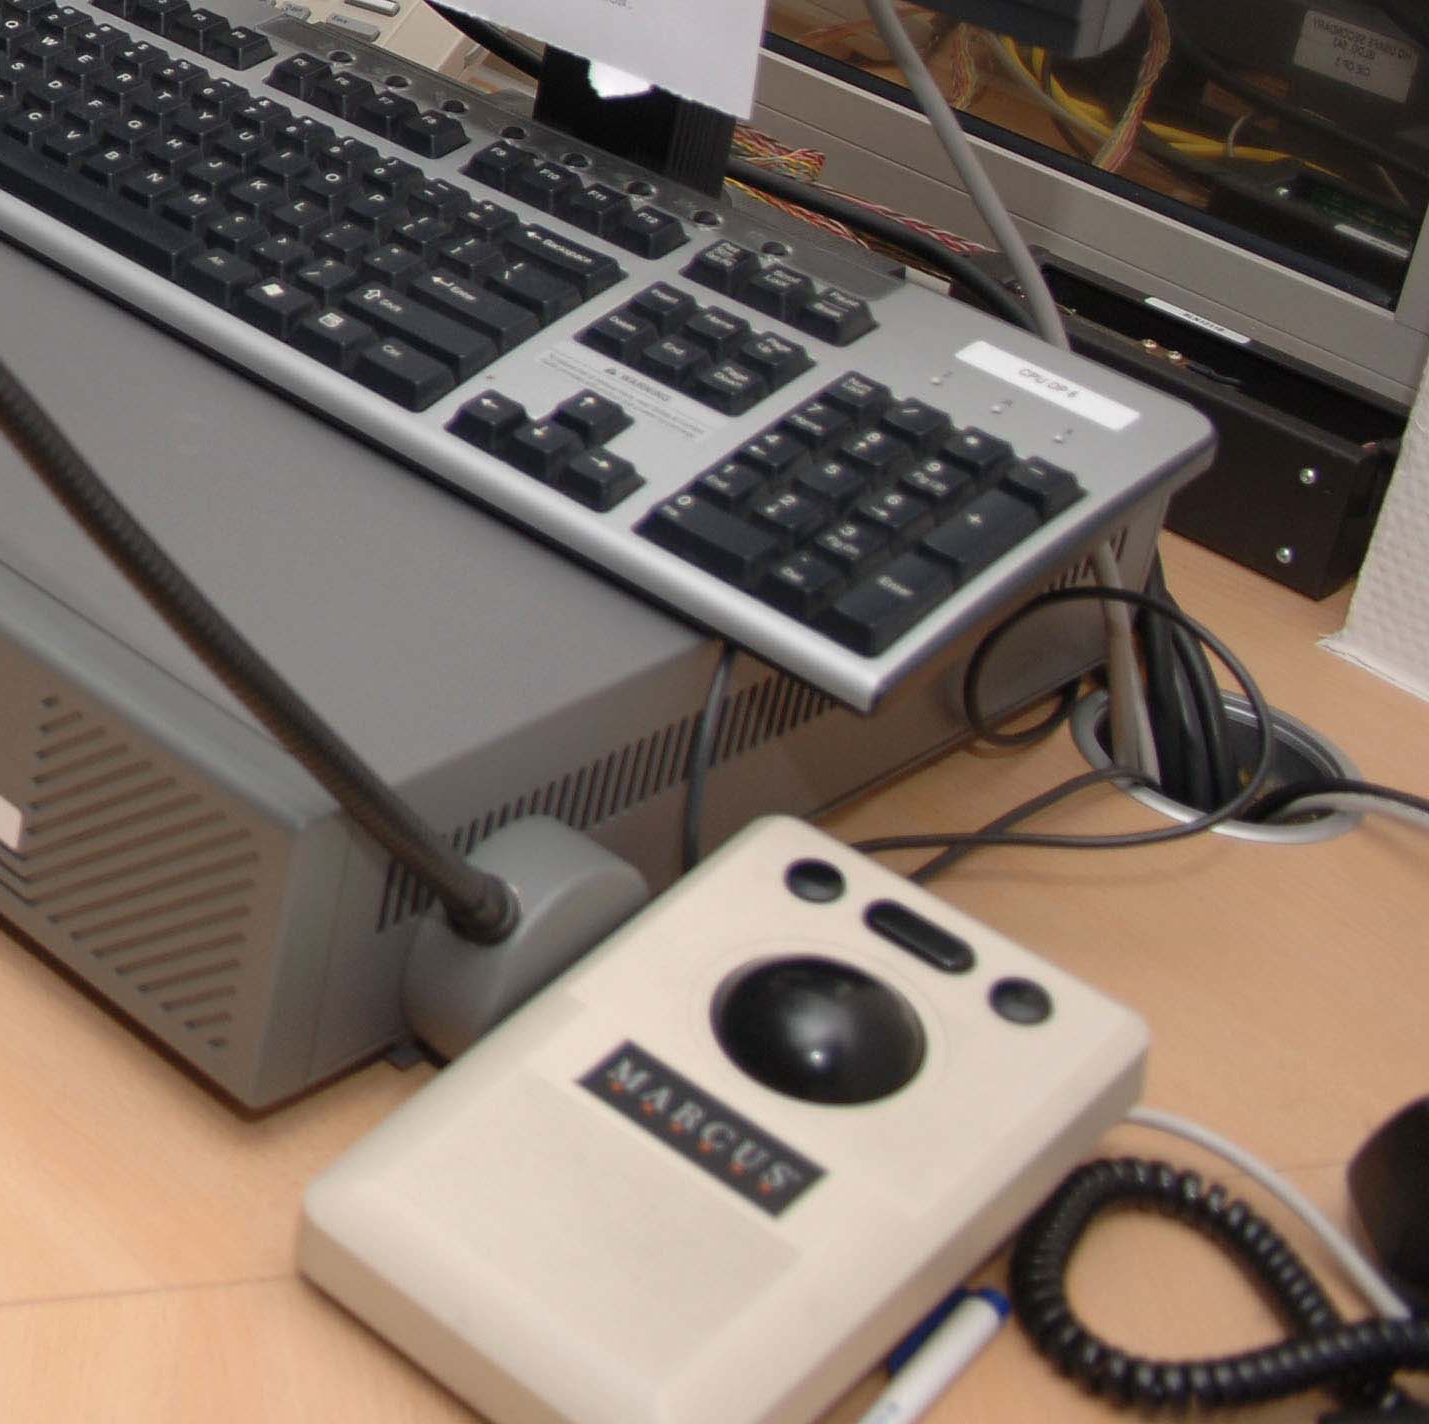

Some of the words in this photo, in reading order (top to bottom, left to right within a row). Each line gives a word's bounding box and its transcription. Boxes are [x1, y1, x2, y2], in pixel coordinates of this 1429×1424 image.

[622, 375, 669, 401] WARNING
[1019, 368, 1045, 384] CPU
[1047, 382, 1068, 392] OP
[606, 1055, 793, 1197] MARCUS
